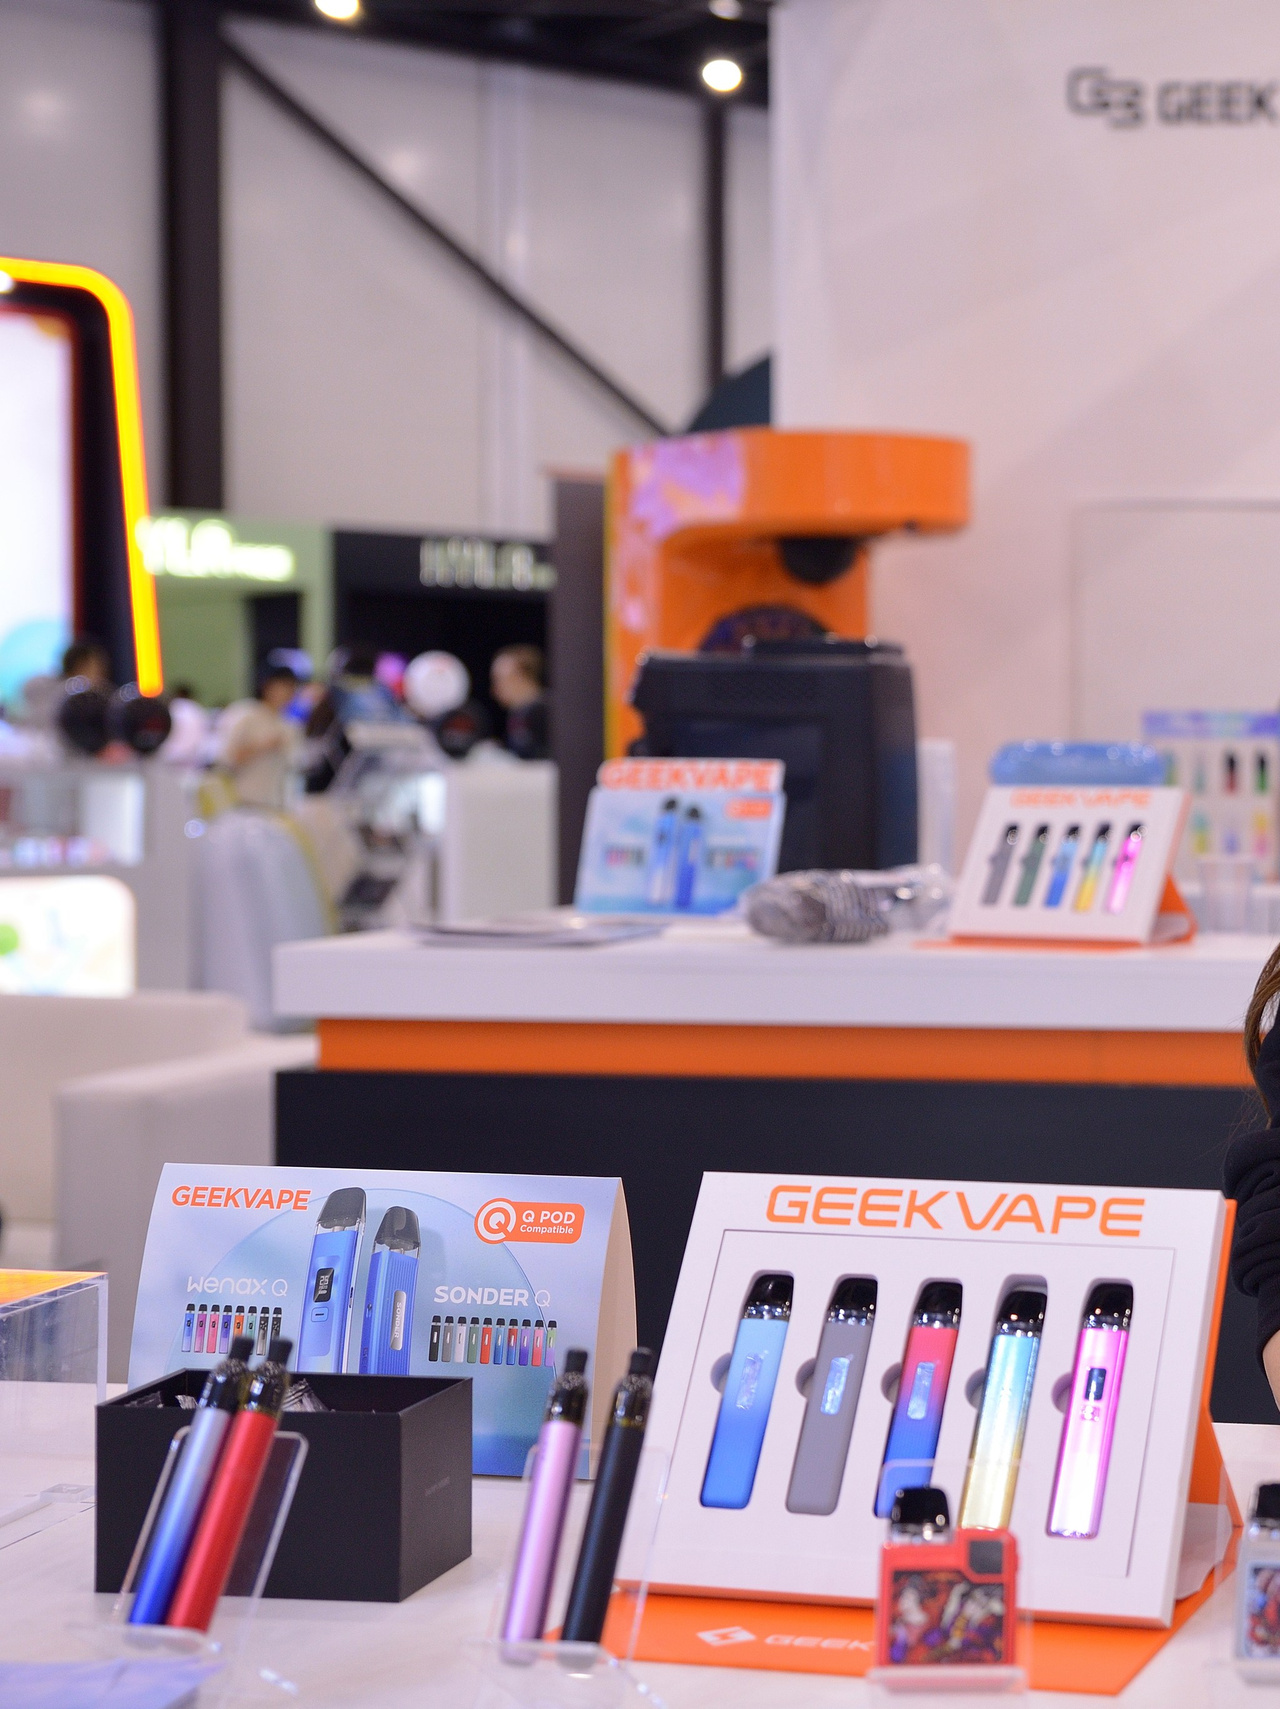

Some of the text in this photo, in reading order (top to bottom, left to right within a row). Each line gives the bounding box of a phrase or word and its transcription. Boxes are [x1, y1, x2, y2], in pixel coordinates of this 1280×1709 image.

[1157, 80, 1279, 126] GEEK
[171, 1185, 312, 1211] GEEKVAPE
[522, 1210, 576, 1225] Q POD
[766, 1184, 1146, 1238] GEEKVAPE
[520, 1224, 574, 1235] Compatible
[271, 1278, 289, 1297] Q
[433, 1285, 550, 1308] SONDER Q
[394, 1301, 403, 1339] SONDER
[764, 1634, 875, 1651] GEEK
